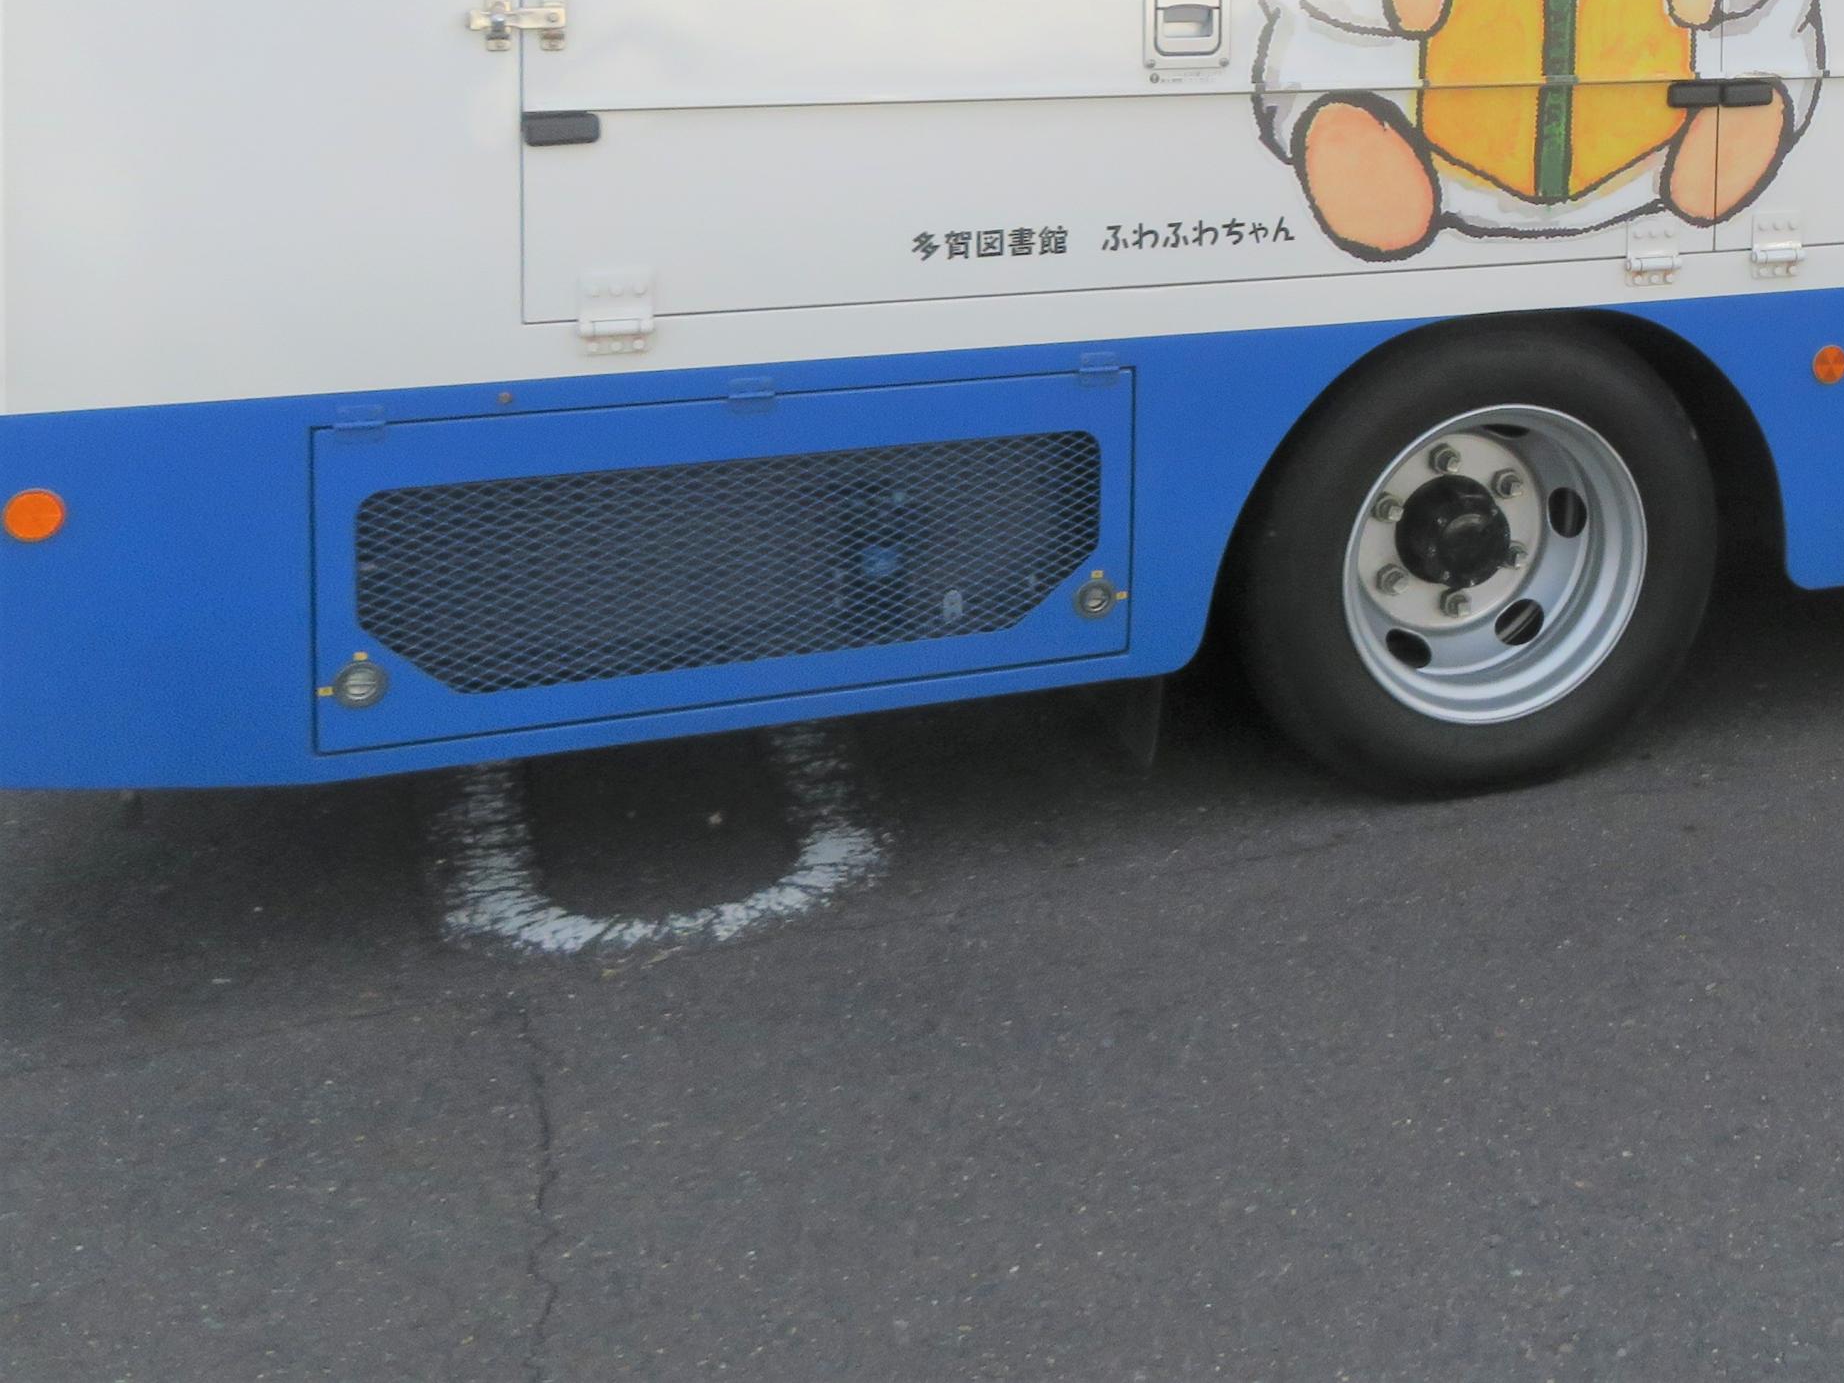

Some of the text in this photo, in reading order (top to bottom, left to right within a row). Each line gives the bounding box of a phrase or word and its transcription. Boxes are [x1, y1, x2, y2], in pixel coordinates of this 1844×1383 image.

[911, 216, 1296, 261] 多賀図書館 ふわふわちゃん
